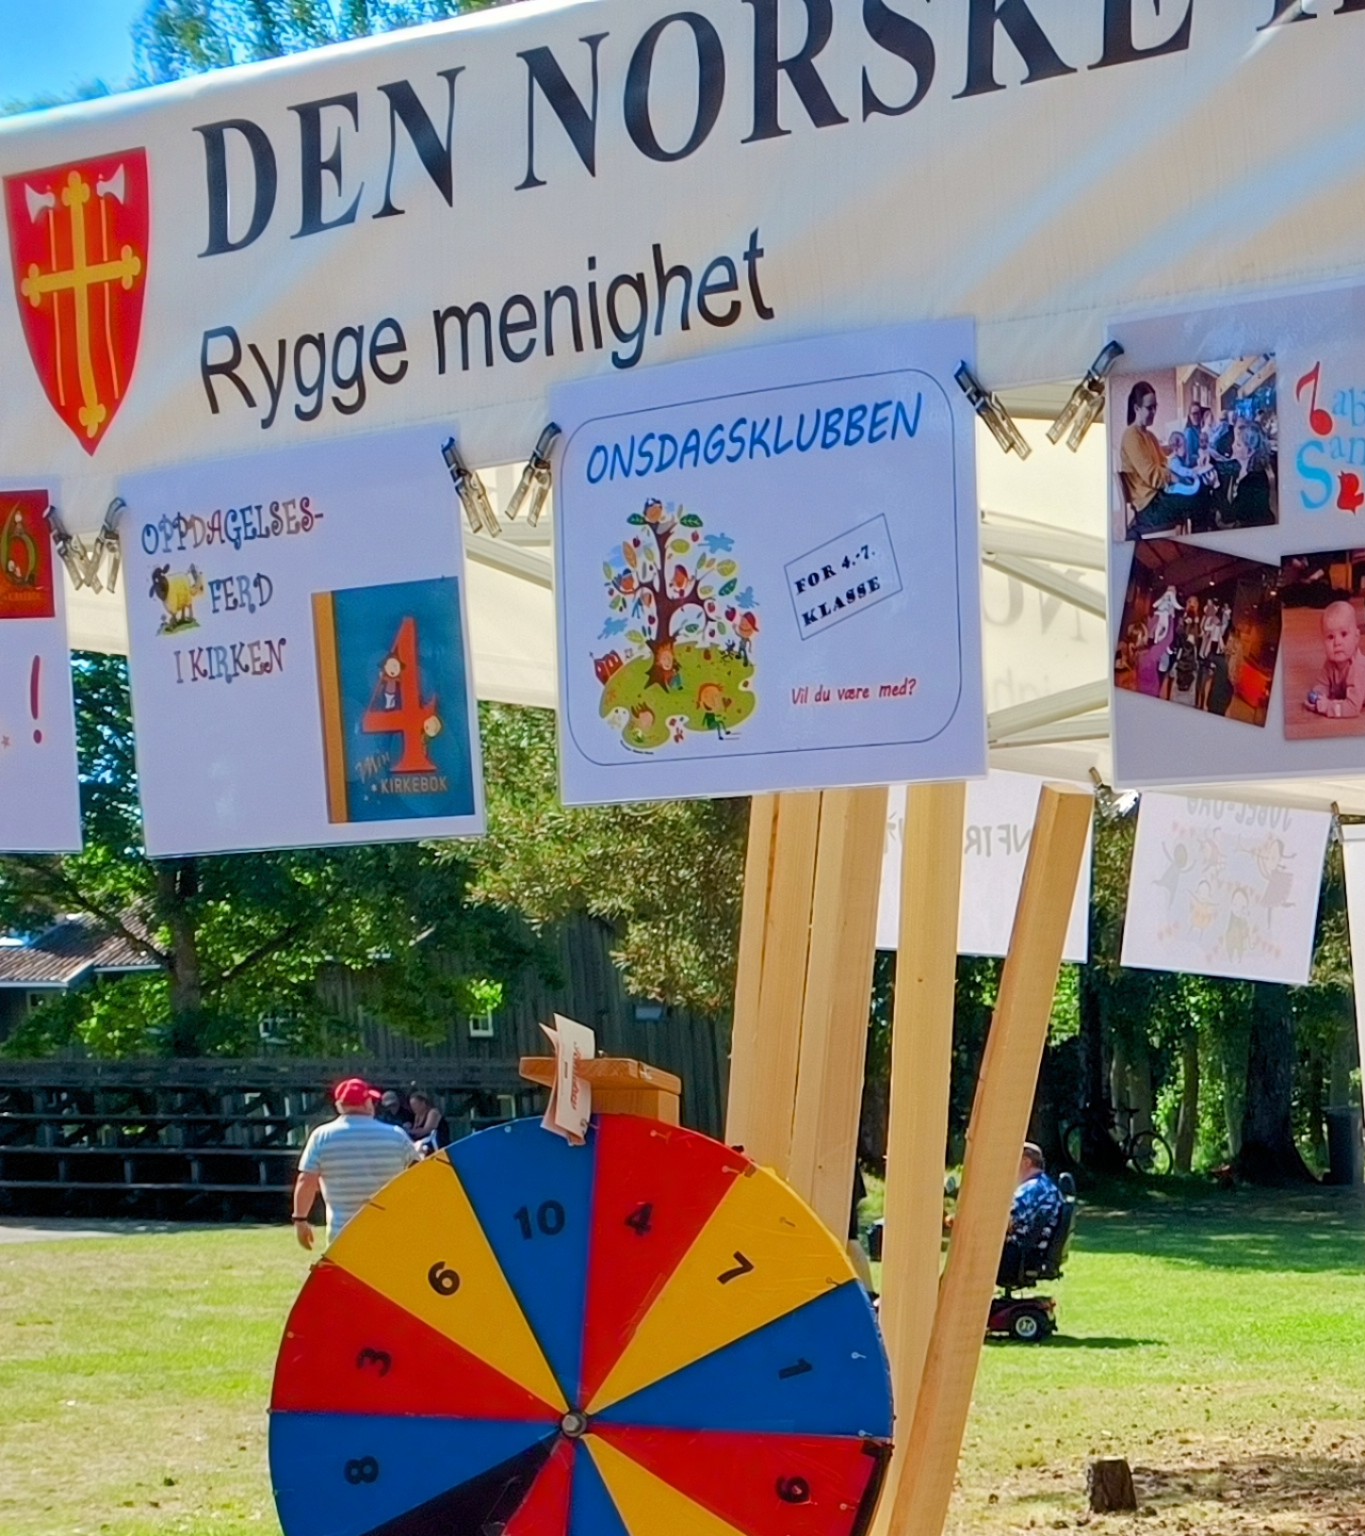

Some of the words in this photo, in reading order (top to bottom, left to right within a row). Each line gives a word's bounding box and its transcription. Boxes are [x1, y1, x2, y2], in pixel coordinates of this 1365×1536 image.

[192, 65, 466, 258] DEN
[200, 309, 409, 429] Rygge
[432, 228, 775, 369] menighet
[585, 392, 923, 484] ONSDAGSKLUBBEN
[141, 496, 324, 555] OPPDAGELSES-
[208, 572, 274, 614] FERD
[794, 564, 837, 596] FOR
[802, 576, 881, 628] KLASSE
[189, 637, 287, 685] KIRKEN
[791, 687, 808, 704] Vil
[815, 685, 830, 702] du
[838, 686, 870, 701] være
[879, 678, 917, 698] med?
[381, 776, 449, 794] KIRKEBOK
[512, 1200, 567, 1240] 10
[624, 1201, 654, 1238] 4
[716, 1250, 755, 1285] 7
[356, 1347, 392, 1378] 3
[777, 1357, 813, 1382] 1
[343, 1456, 380, 1485] 8
